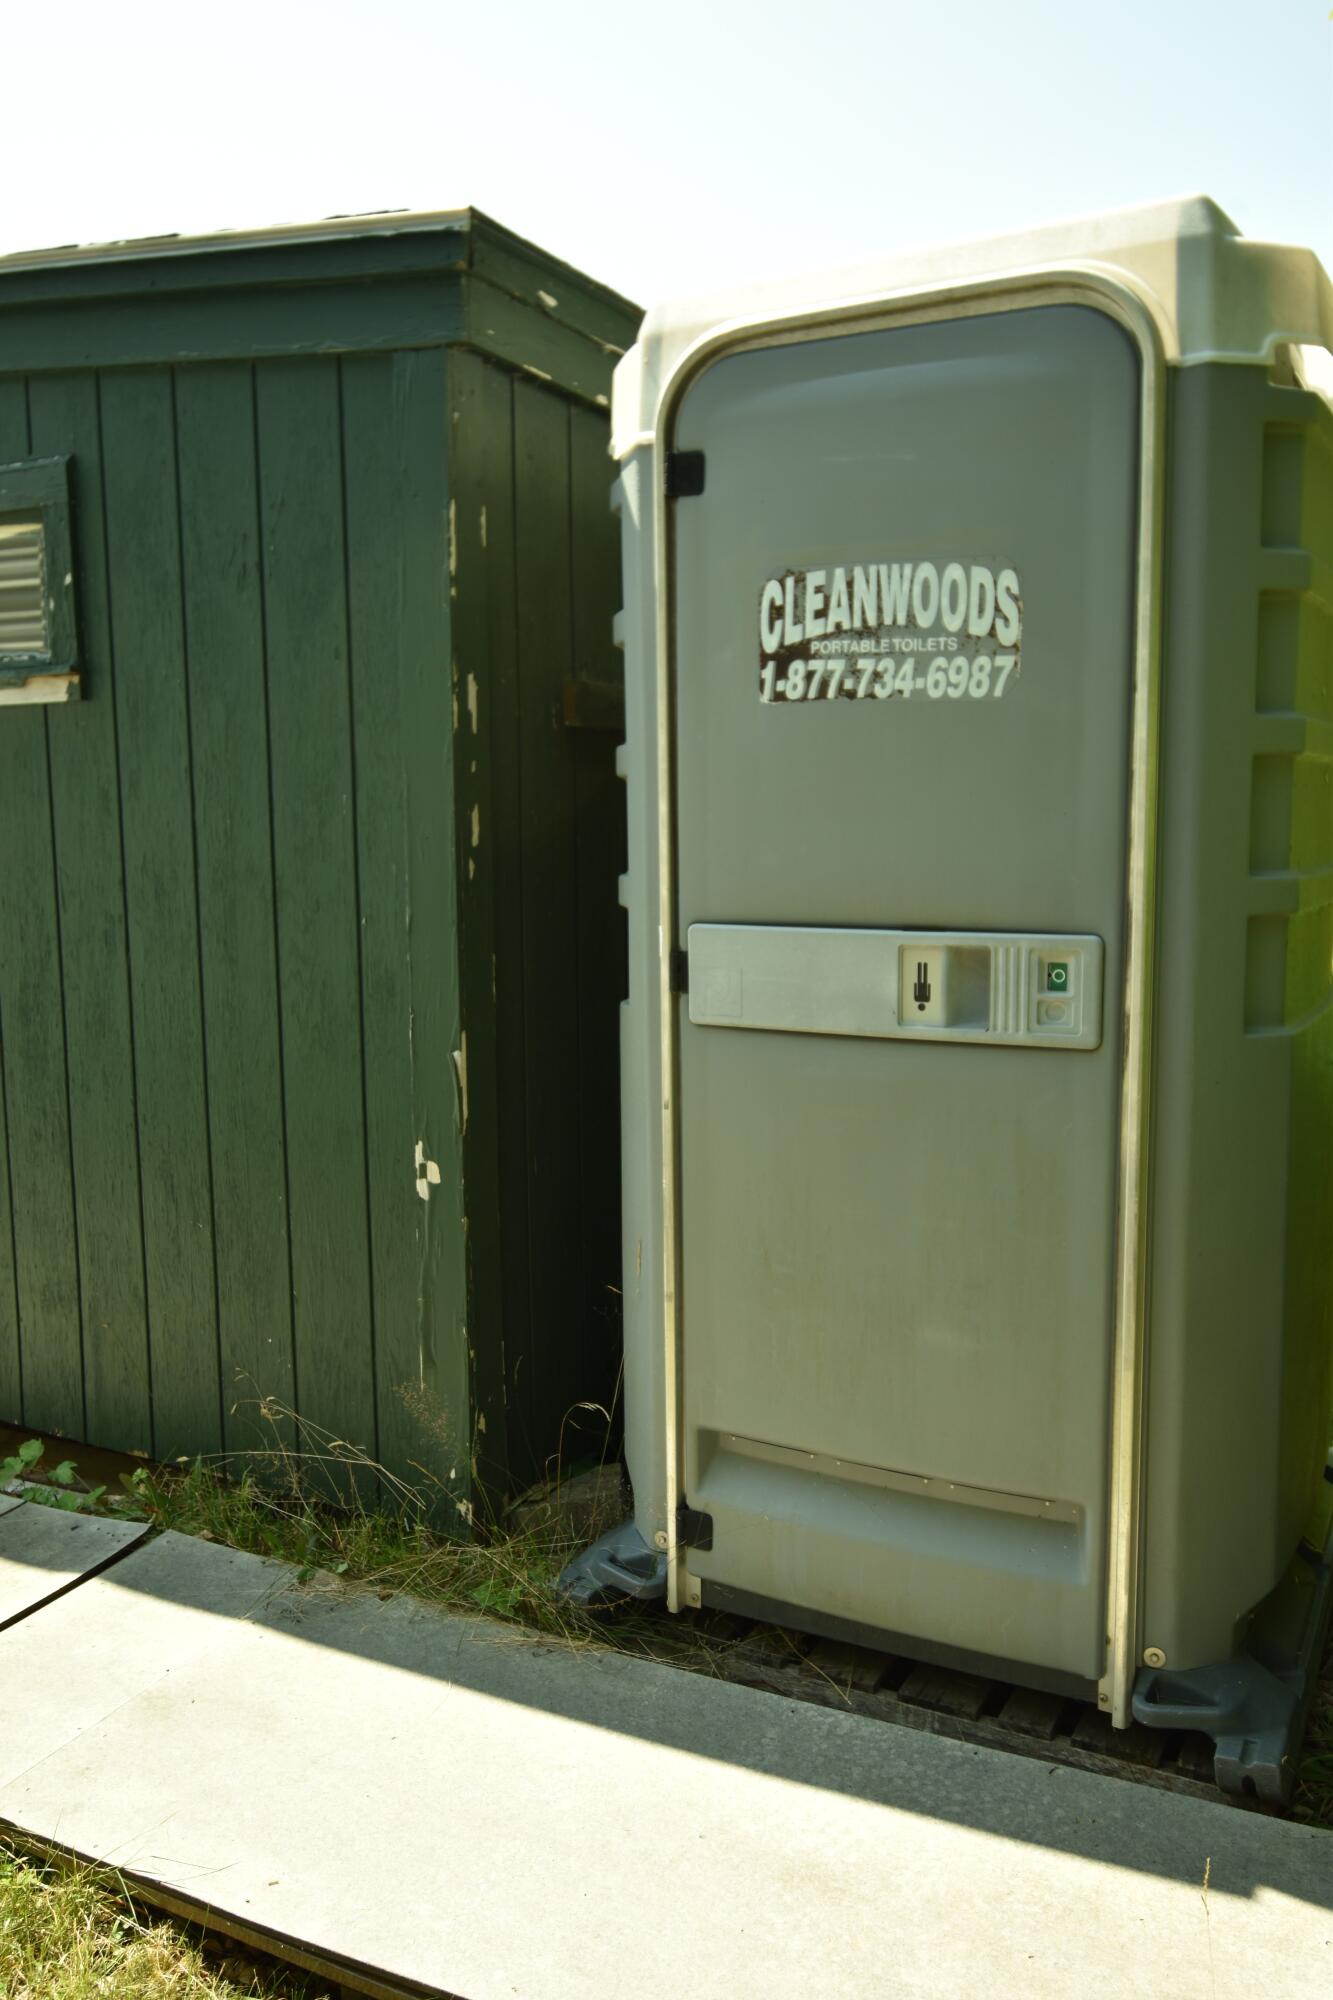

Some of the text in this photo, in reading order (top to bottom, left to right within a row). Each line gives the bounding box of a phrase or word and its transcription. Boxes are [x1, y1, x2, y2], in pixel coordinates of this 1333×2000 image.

[760, 562, 1020, 654] CLEANWOODS
[810, 637, 958, 654] PORTABLE TOILETS
[760, 655, 1016, 703] 1-877-734-6987
